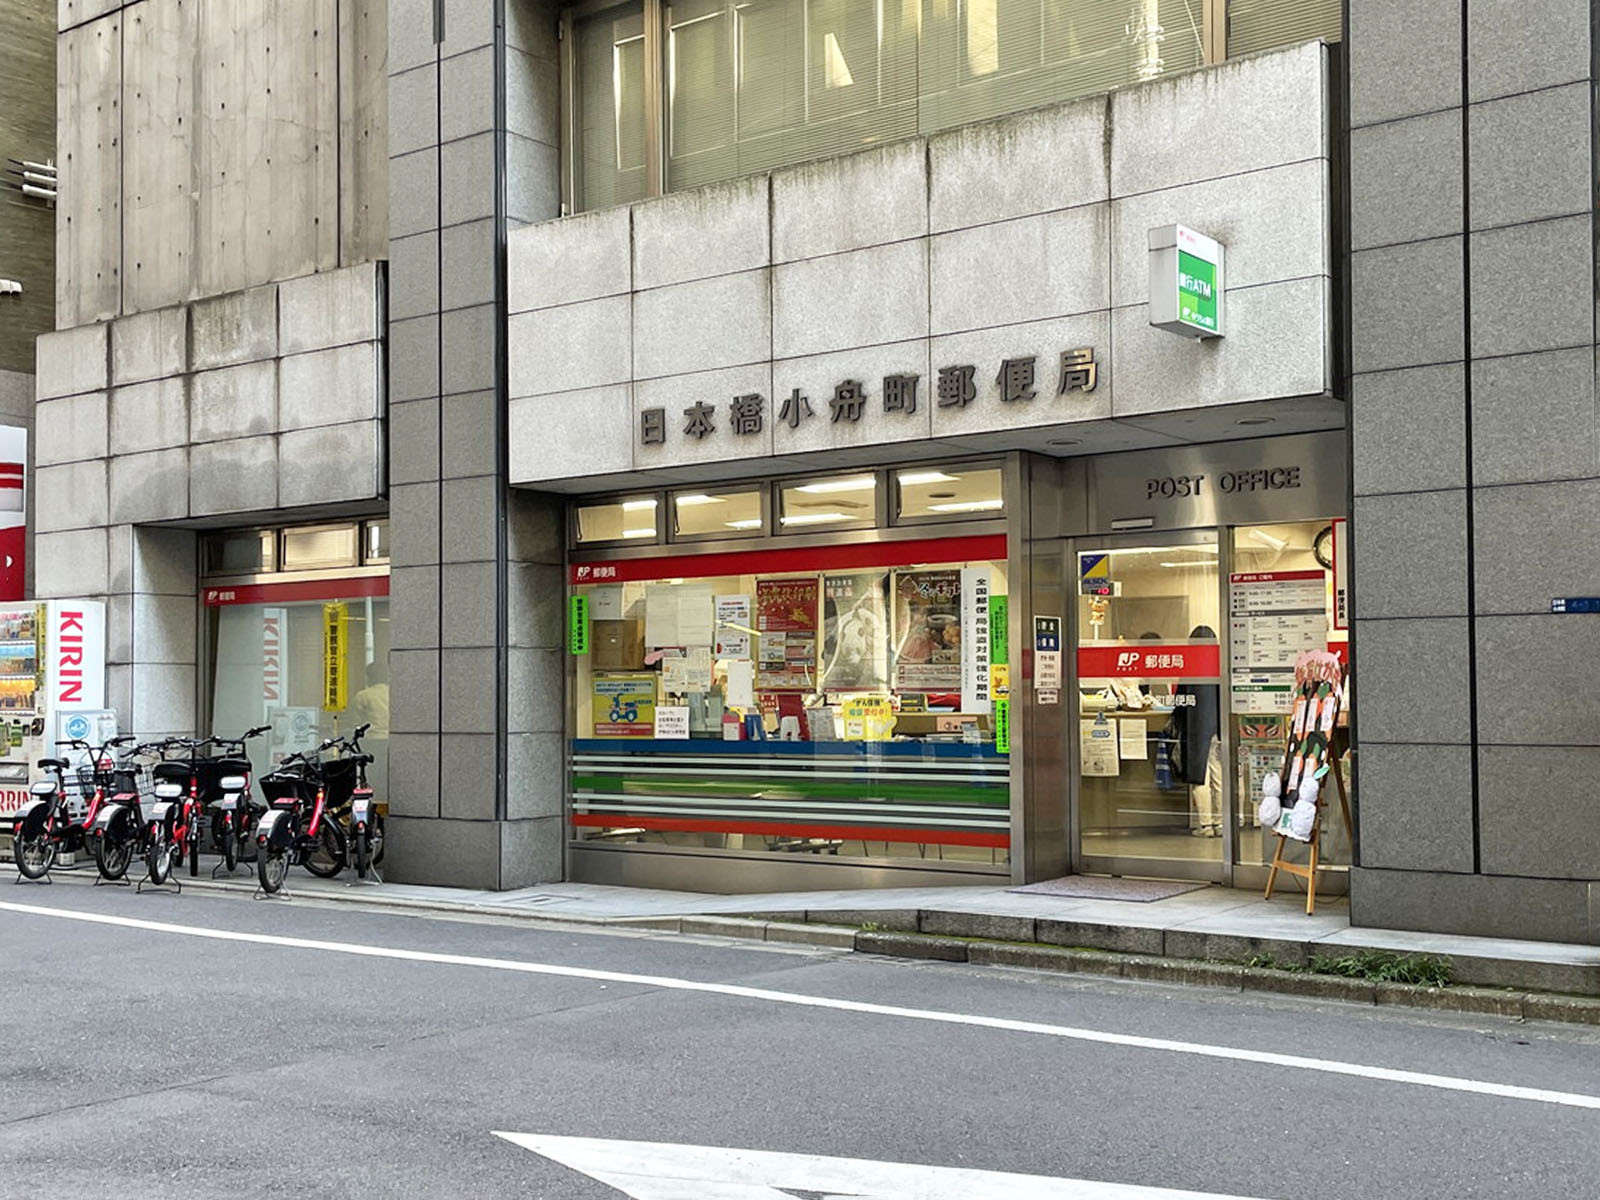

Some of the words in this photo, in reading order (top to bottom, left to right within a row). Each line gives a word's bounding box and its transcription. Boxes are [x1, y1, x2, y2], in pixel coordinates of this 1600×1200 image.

[641, 347, 1098, 445] 日本橋小舟町郵便局
[1147, 475, 1204, 499] POST
[1220, 466, 1301, 493] OFFICE
[59, 611, 83, 703] KIRIN
[976, 577, 988, 701] 全国郵便局強盗対策強化期間
[1144, 654, 1184, 669] 郵便局
